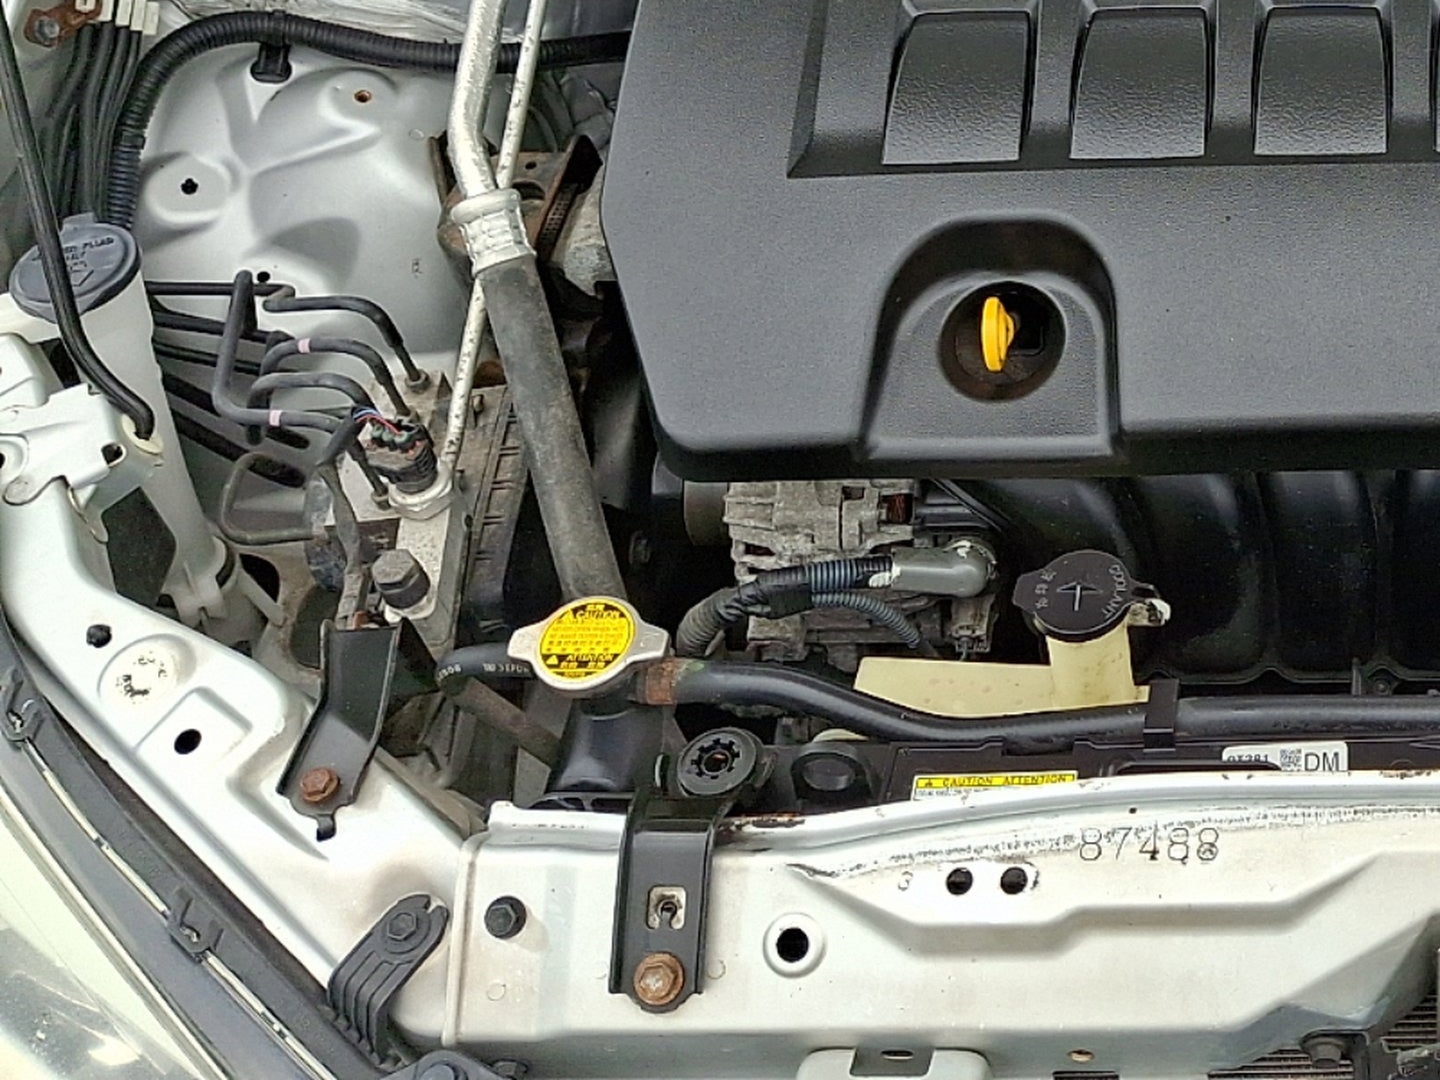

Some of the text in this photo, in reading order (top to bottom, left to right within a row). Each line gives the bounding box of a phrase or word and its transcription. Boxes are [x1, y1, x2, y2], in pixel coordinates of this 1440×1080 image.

[1304, 751, 1340, 772] DM
[942, 773, 1065, 787] CAUTION ATTENTION
